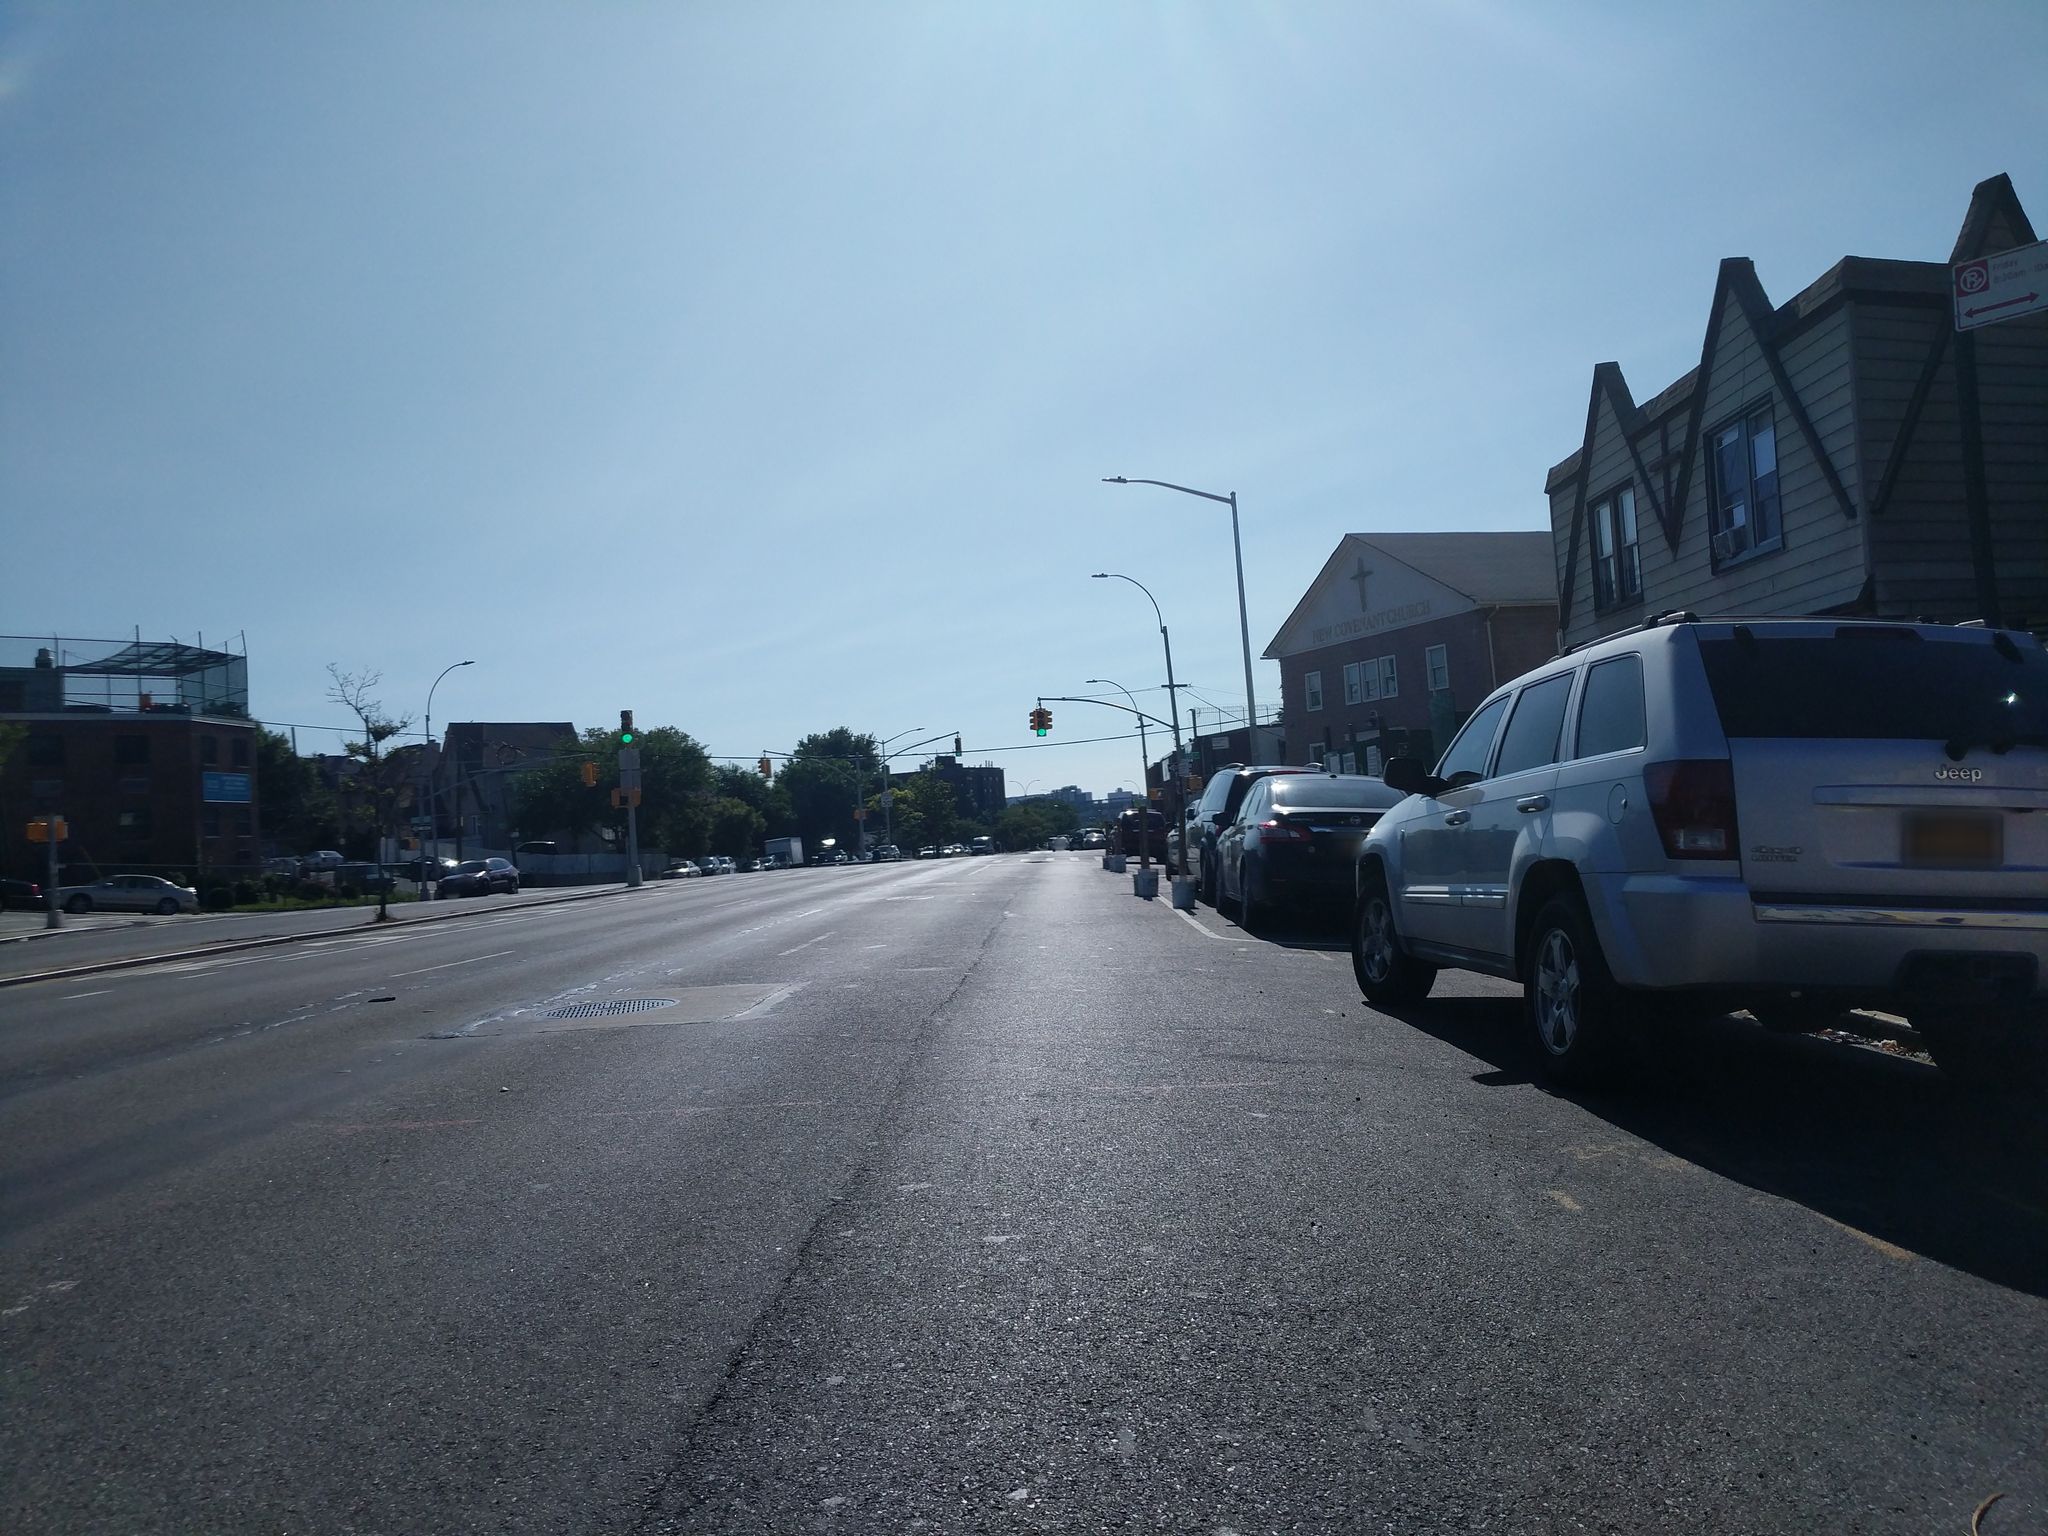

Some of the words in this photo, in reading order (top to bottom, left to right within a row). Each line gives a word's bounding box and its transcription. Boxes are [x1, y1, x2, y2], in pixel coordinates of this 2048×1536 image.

[1312, 625, 1332, 644] NEW
[1335, 611, 1385, 636] COVENANT
[1387, 600, 1431, 624] CHURCH
[1935, 765, 1982, 782] Jeep
